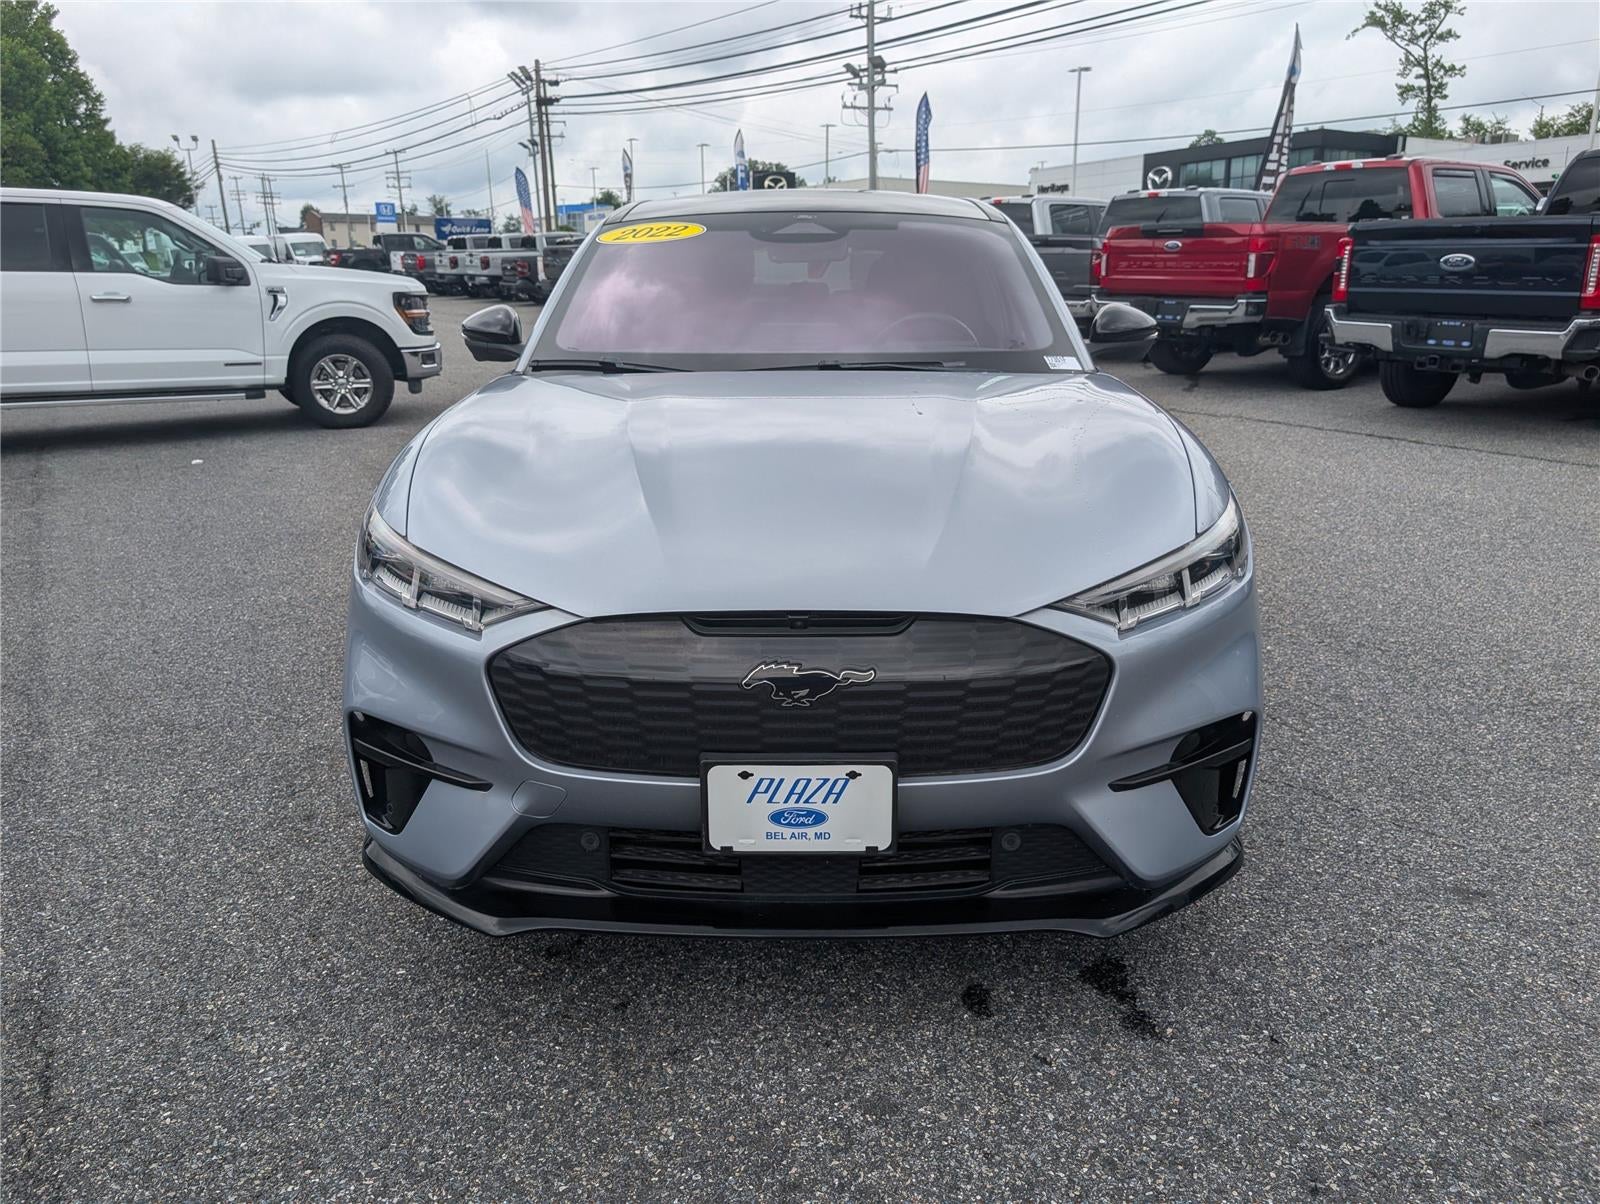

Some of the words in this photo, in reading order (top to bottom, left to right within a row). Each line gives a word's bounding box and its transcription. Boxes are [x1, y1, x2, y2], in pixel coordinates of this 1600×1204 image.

[1504, 157, 1549, 170] Service
[451, 224, 471, 233] Quick
[613, 226, 689, 241] 2022
[746, 777, 850, 804] PLAZA
[780, 810, 816, 825] Ford
[765, 831, 787, 840] BEL
[789, 831, 811, 841] AIR,
[814, 831, 831, 840] MD
